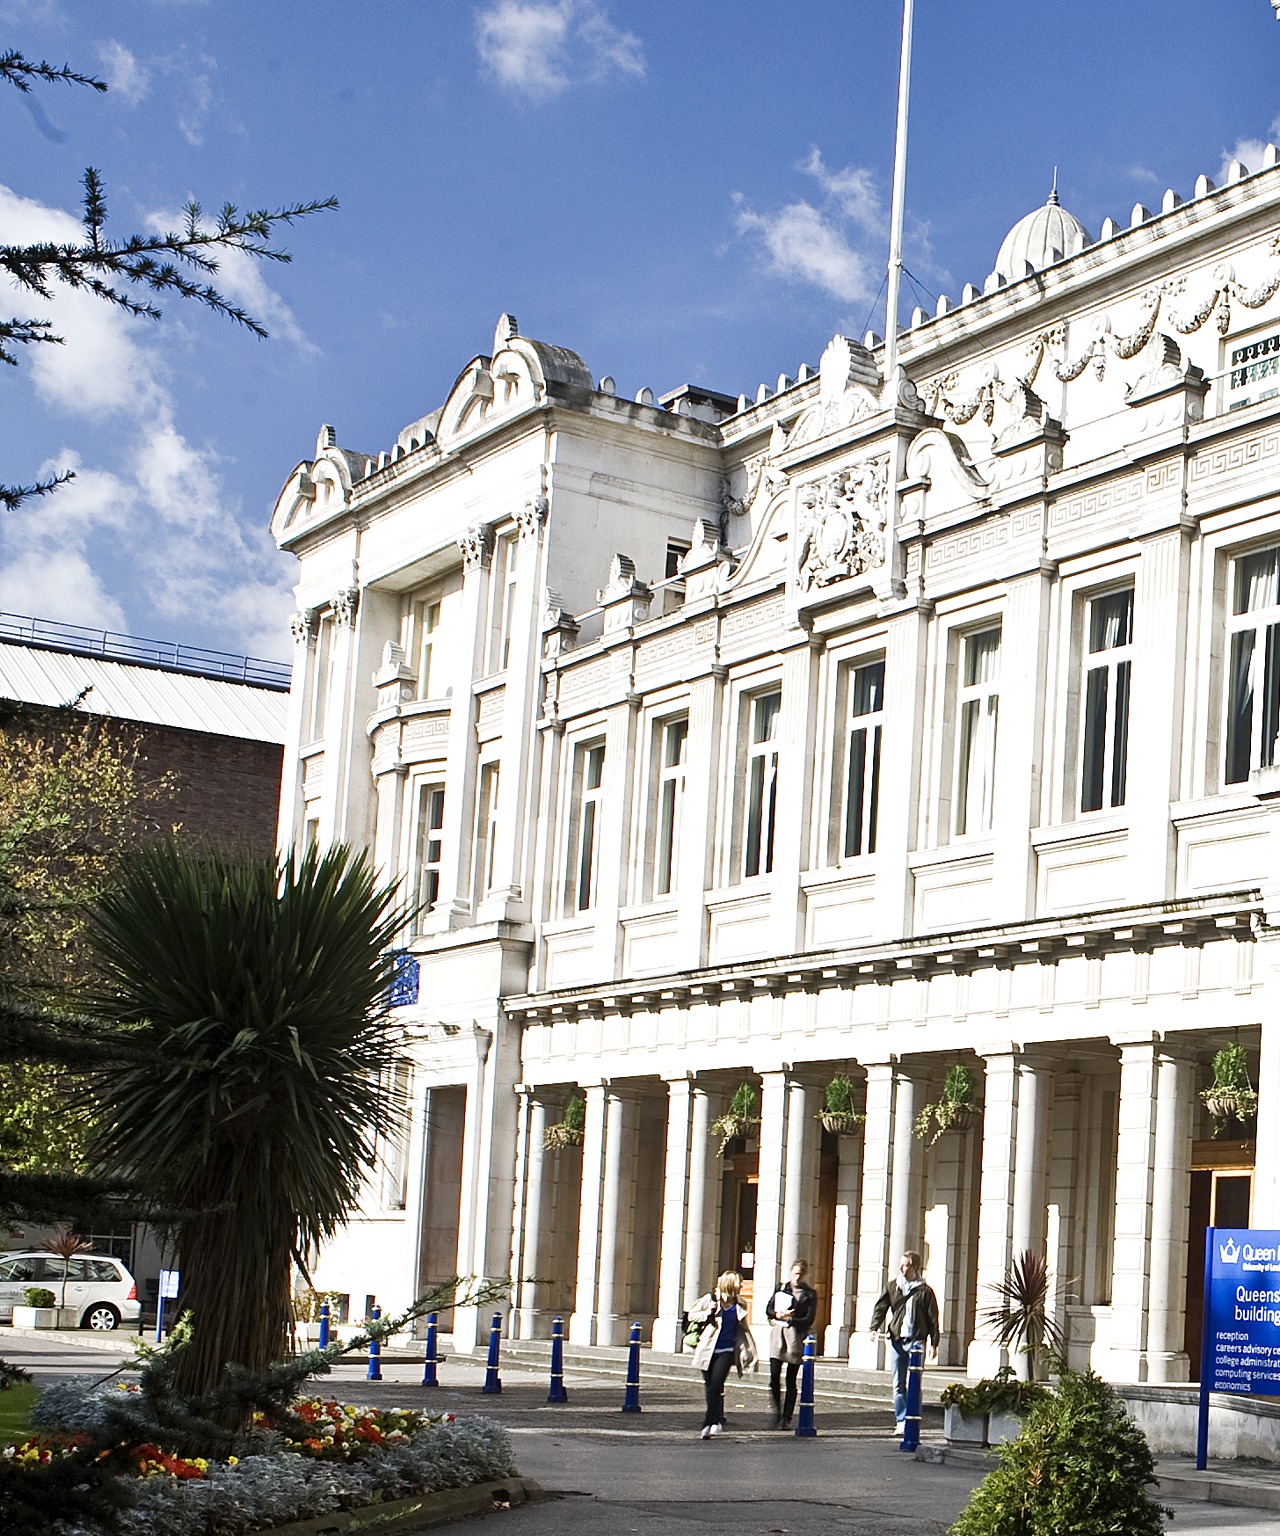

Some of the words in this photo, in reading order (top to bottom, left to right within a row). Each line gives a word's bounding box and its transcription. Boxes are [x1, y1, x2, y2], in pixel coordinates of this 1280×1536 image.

[1242, 1244, 1276, 1261] Queen
[1216, 1331, 1249, 1342] reception
[1216, 1344, 1242, 1353] careers
[1242, 1344, 1273, 1357] advisory
[1215, 1355, 1239, 1367] college
[1215, 1368, 1251, 1381] computing
[1214, 1380, 1251, 1391] economics
